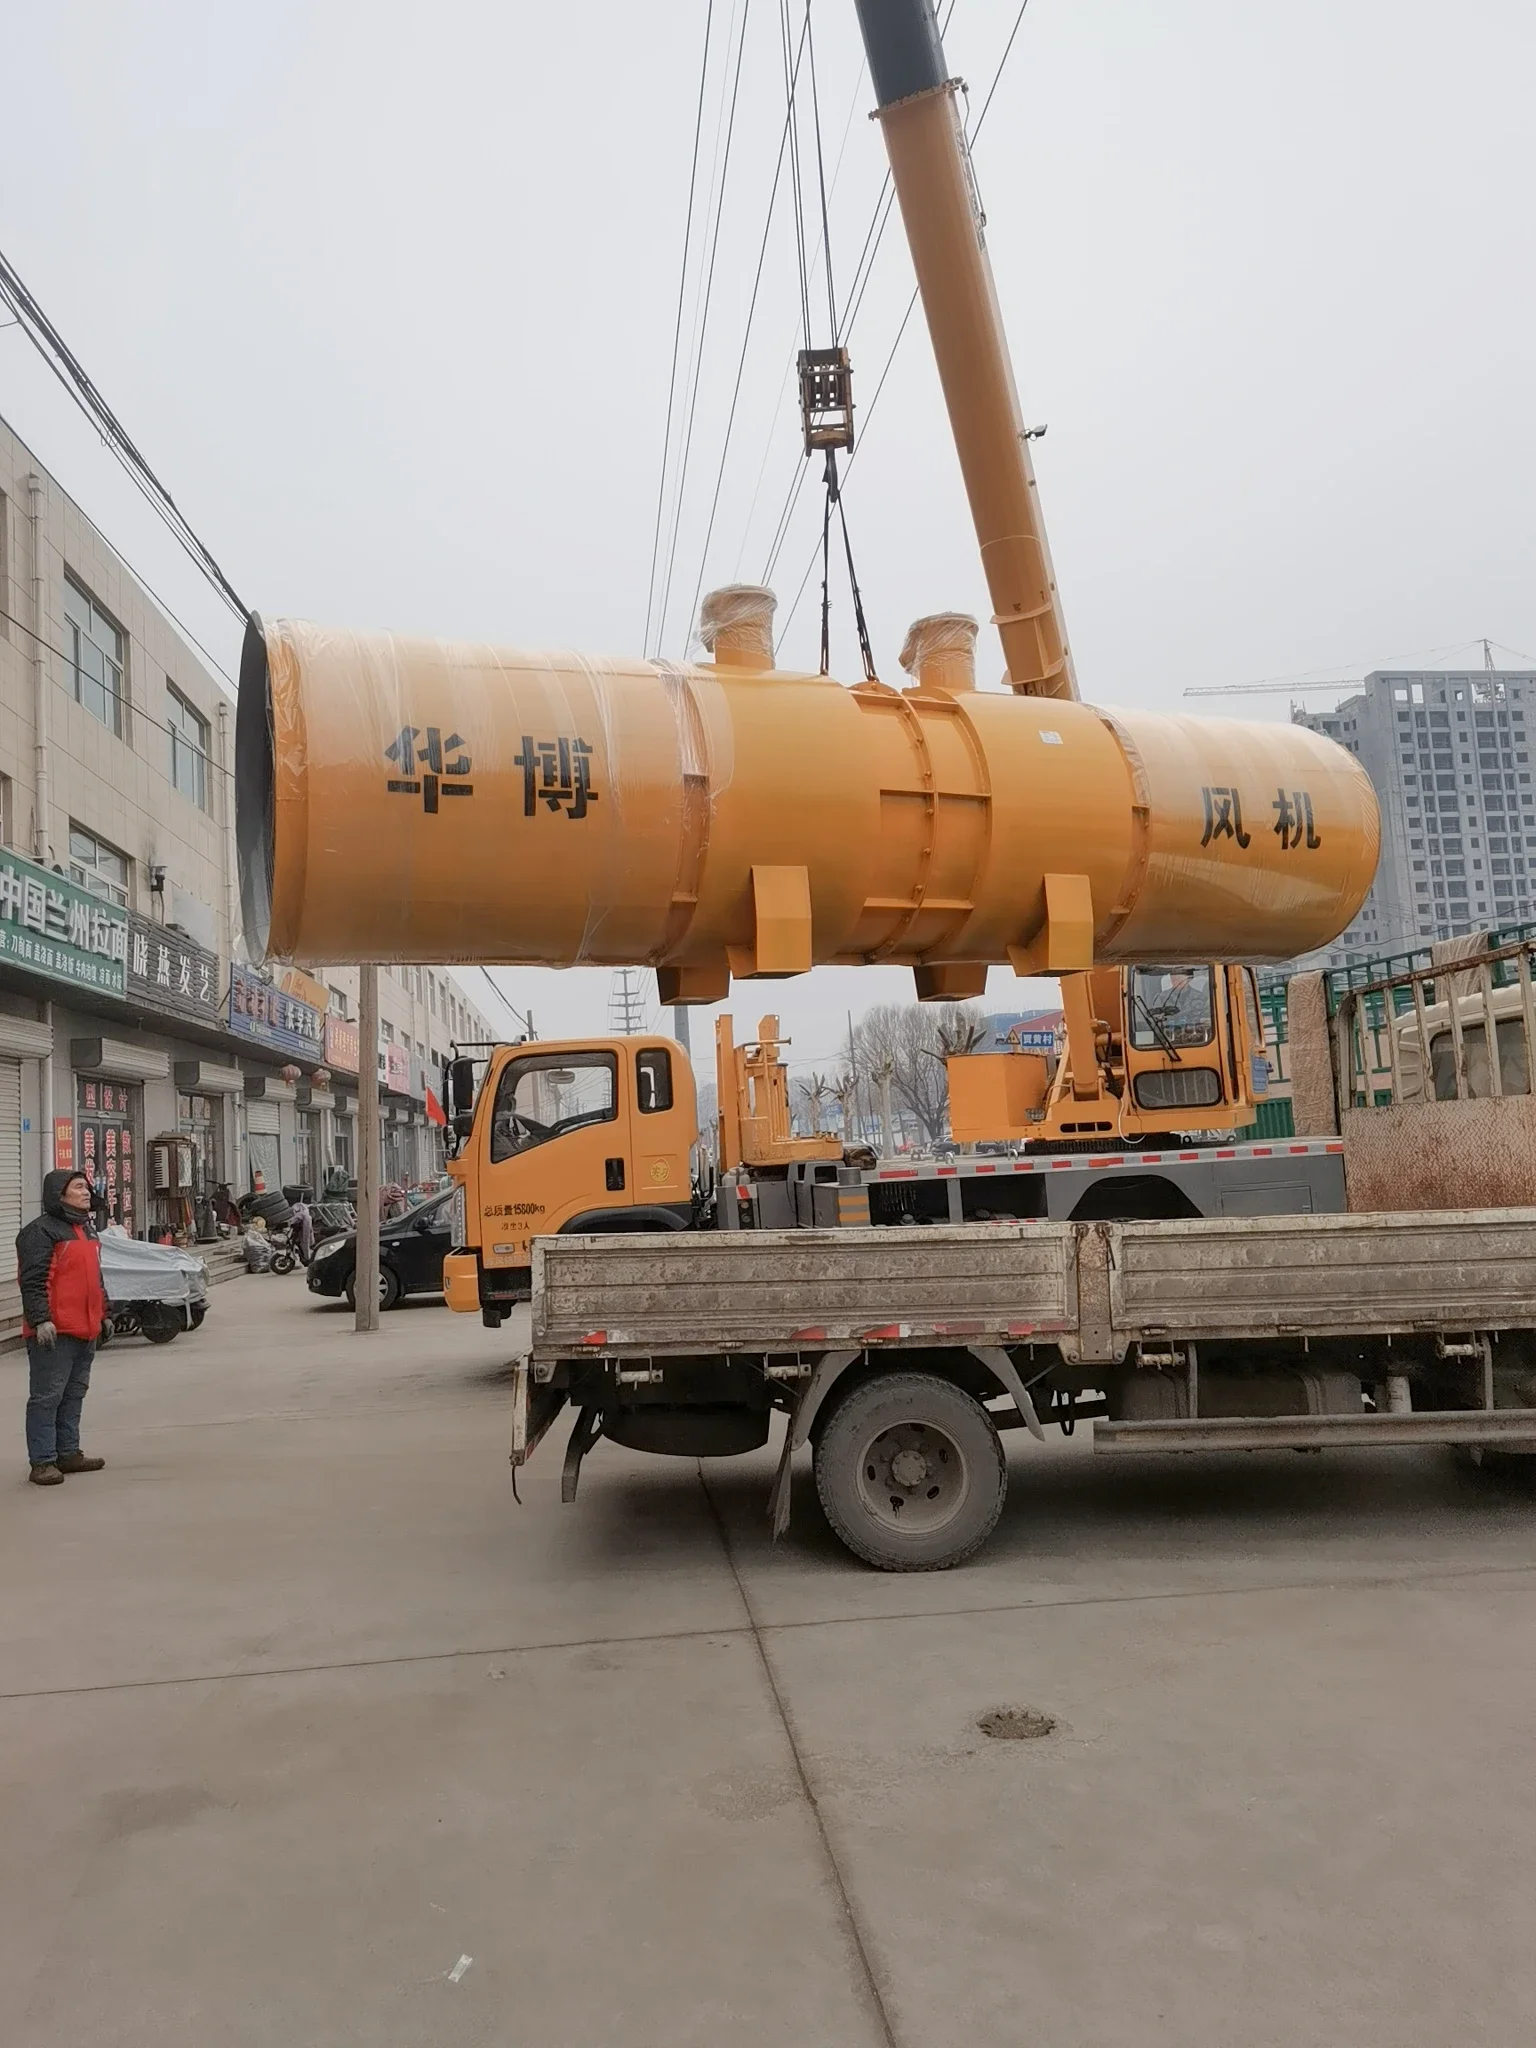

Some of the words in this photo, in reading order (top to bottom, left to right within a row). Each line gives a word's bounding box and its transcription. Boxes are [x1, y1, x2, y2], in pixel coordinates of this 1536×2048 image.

[384, 724, 599, 820] 华博
[1200, 786, 1322, 850] 风机
[0, 865, 127, 962] 中国兰州拉面
[132, 932, 211, 1002] 晓燕发艺
[484, 1202, 546, 1217] 总质量15800kg
